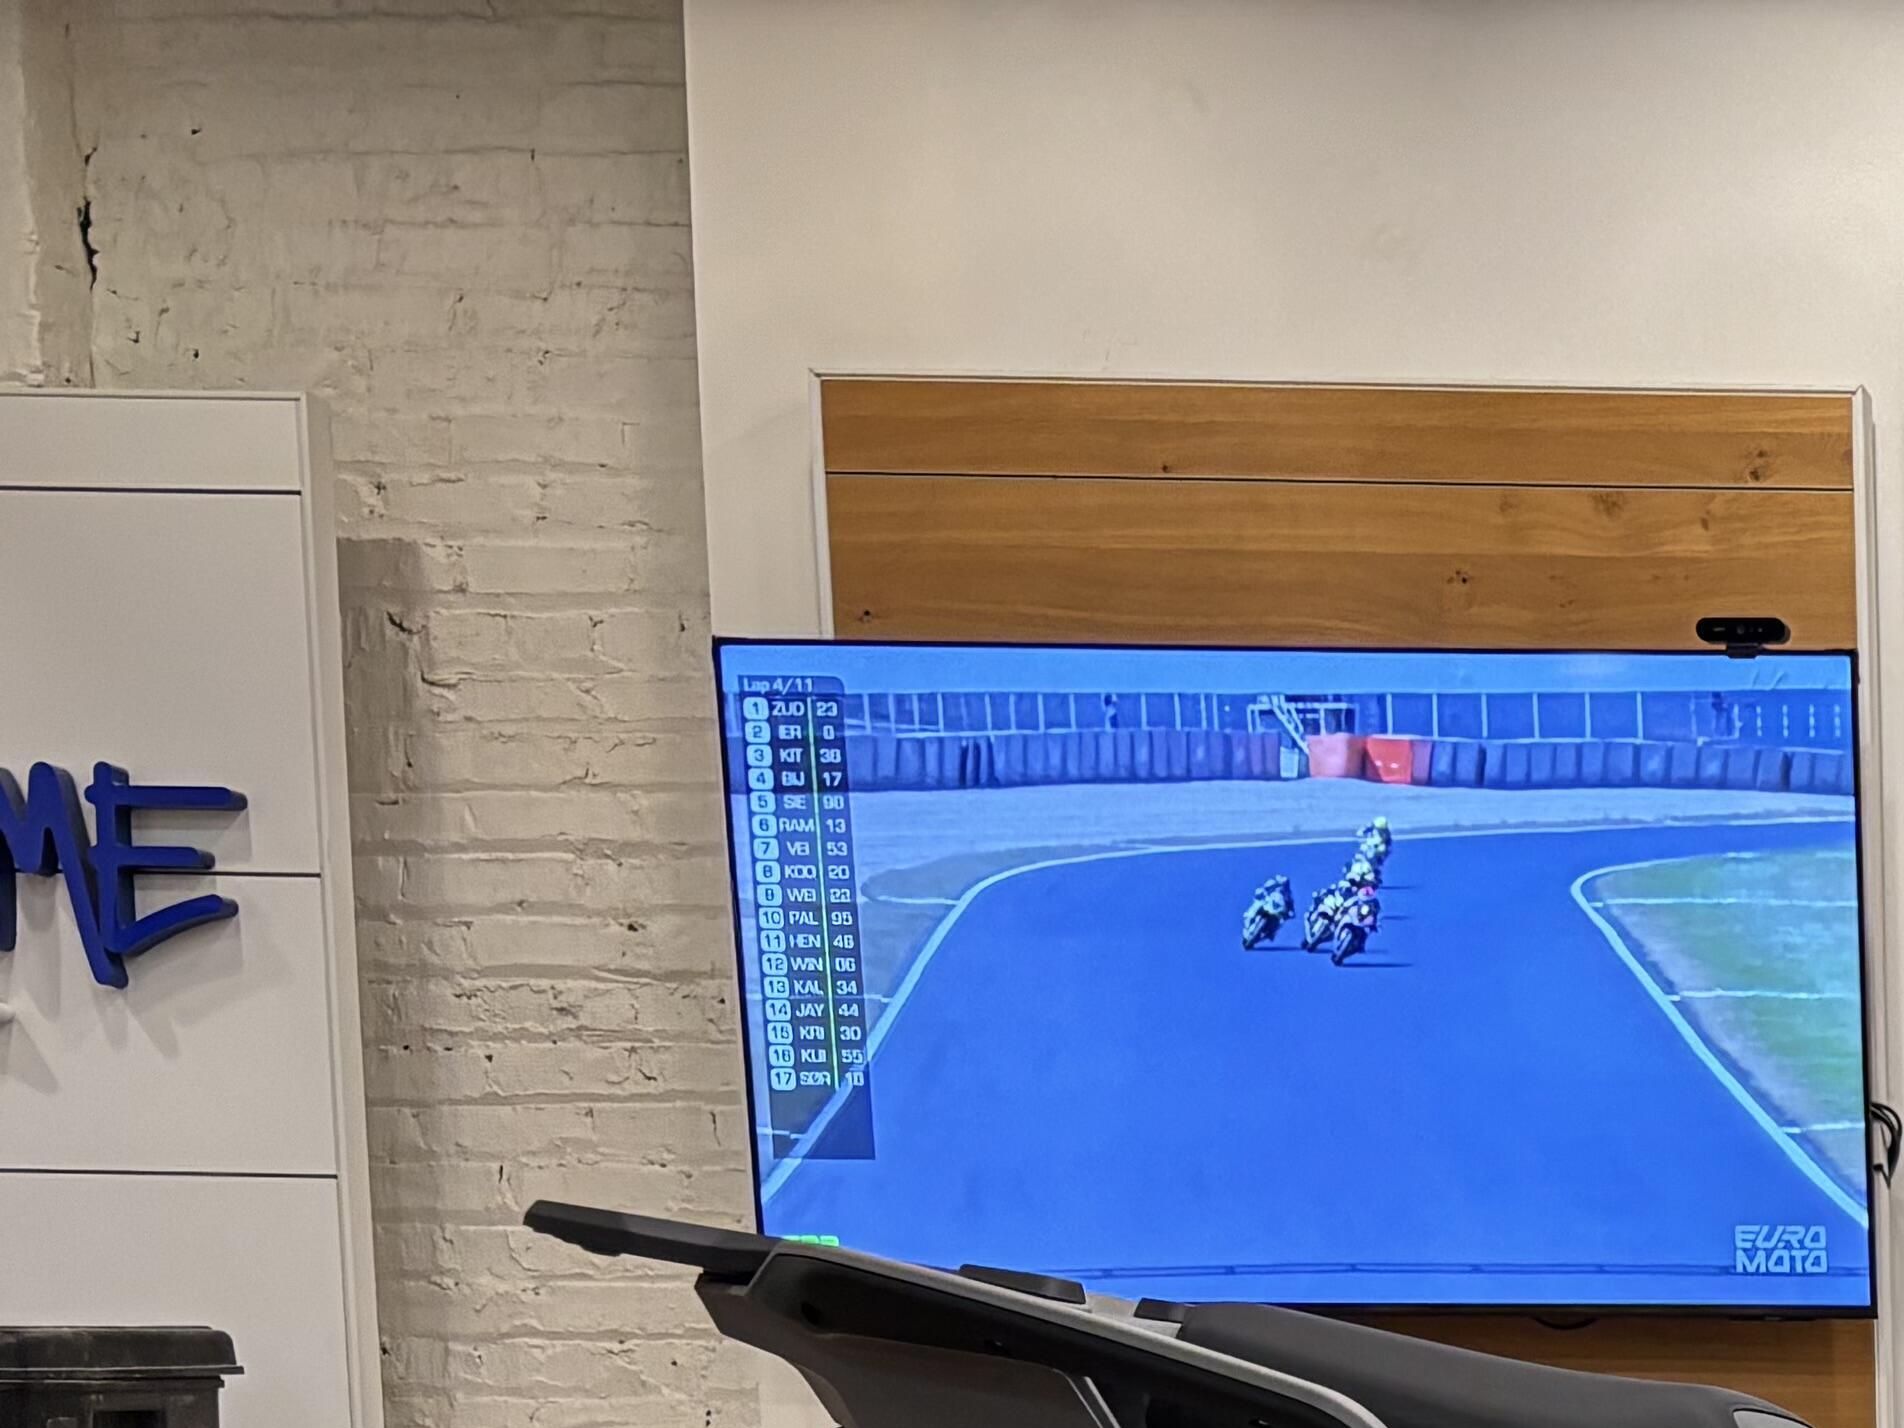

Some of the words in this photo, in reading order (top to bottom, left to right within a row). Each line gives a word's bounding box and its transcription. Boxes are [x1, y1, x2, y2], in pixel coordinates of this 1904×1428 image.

[744, 678, 770, 694] Lap
[773, 677, 813, 695] 4/11
[823, 772, 842, 787] 17
[779, 819, 815, 832] RAM
[826, 819, 846, 833] 13
[827, 841, 848, 856] 53
[836, 980, 857, 994] 34
[796, 1003, 825, 1017] JAY
[839, 1003, 859, 1017] 44
[840, 1026, 861, 1040] 30
[1735, 1225, 1826, 1249] EURO
[1736, 1249, 1828, 1273] MOTO
